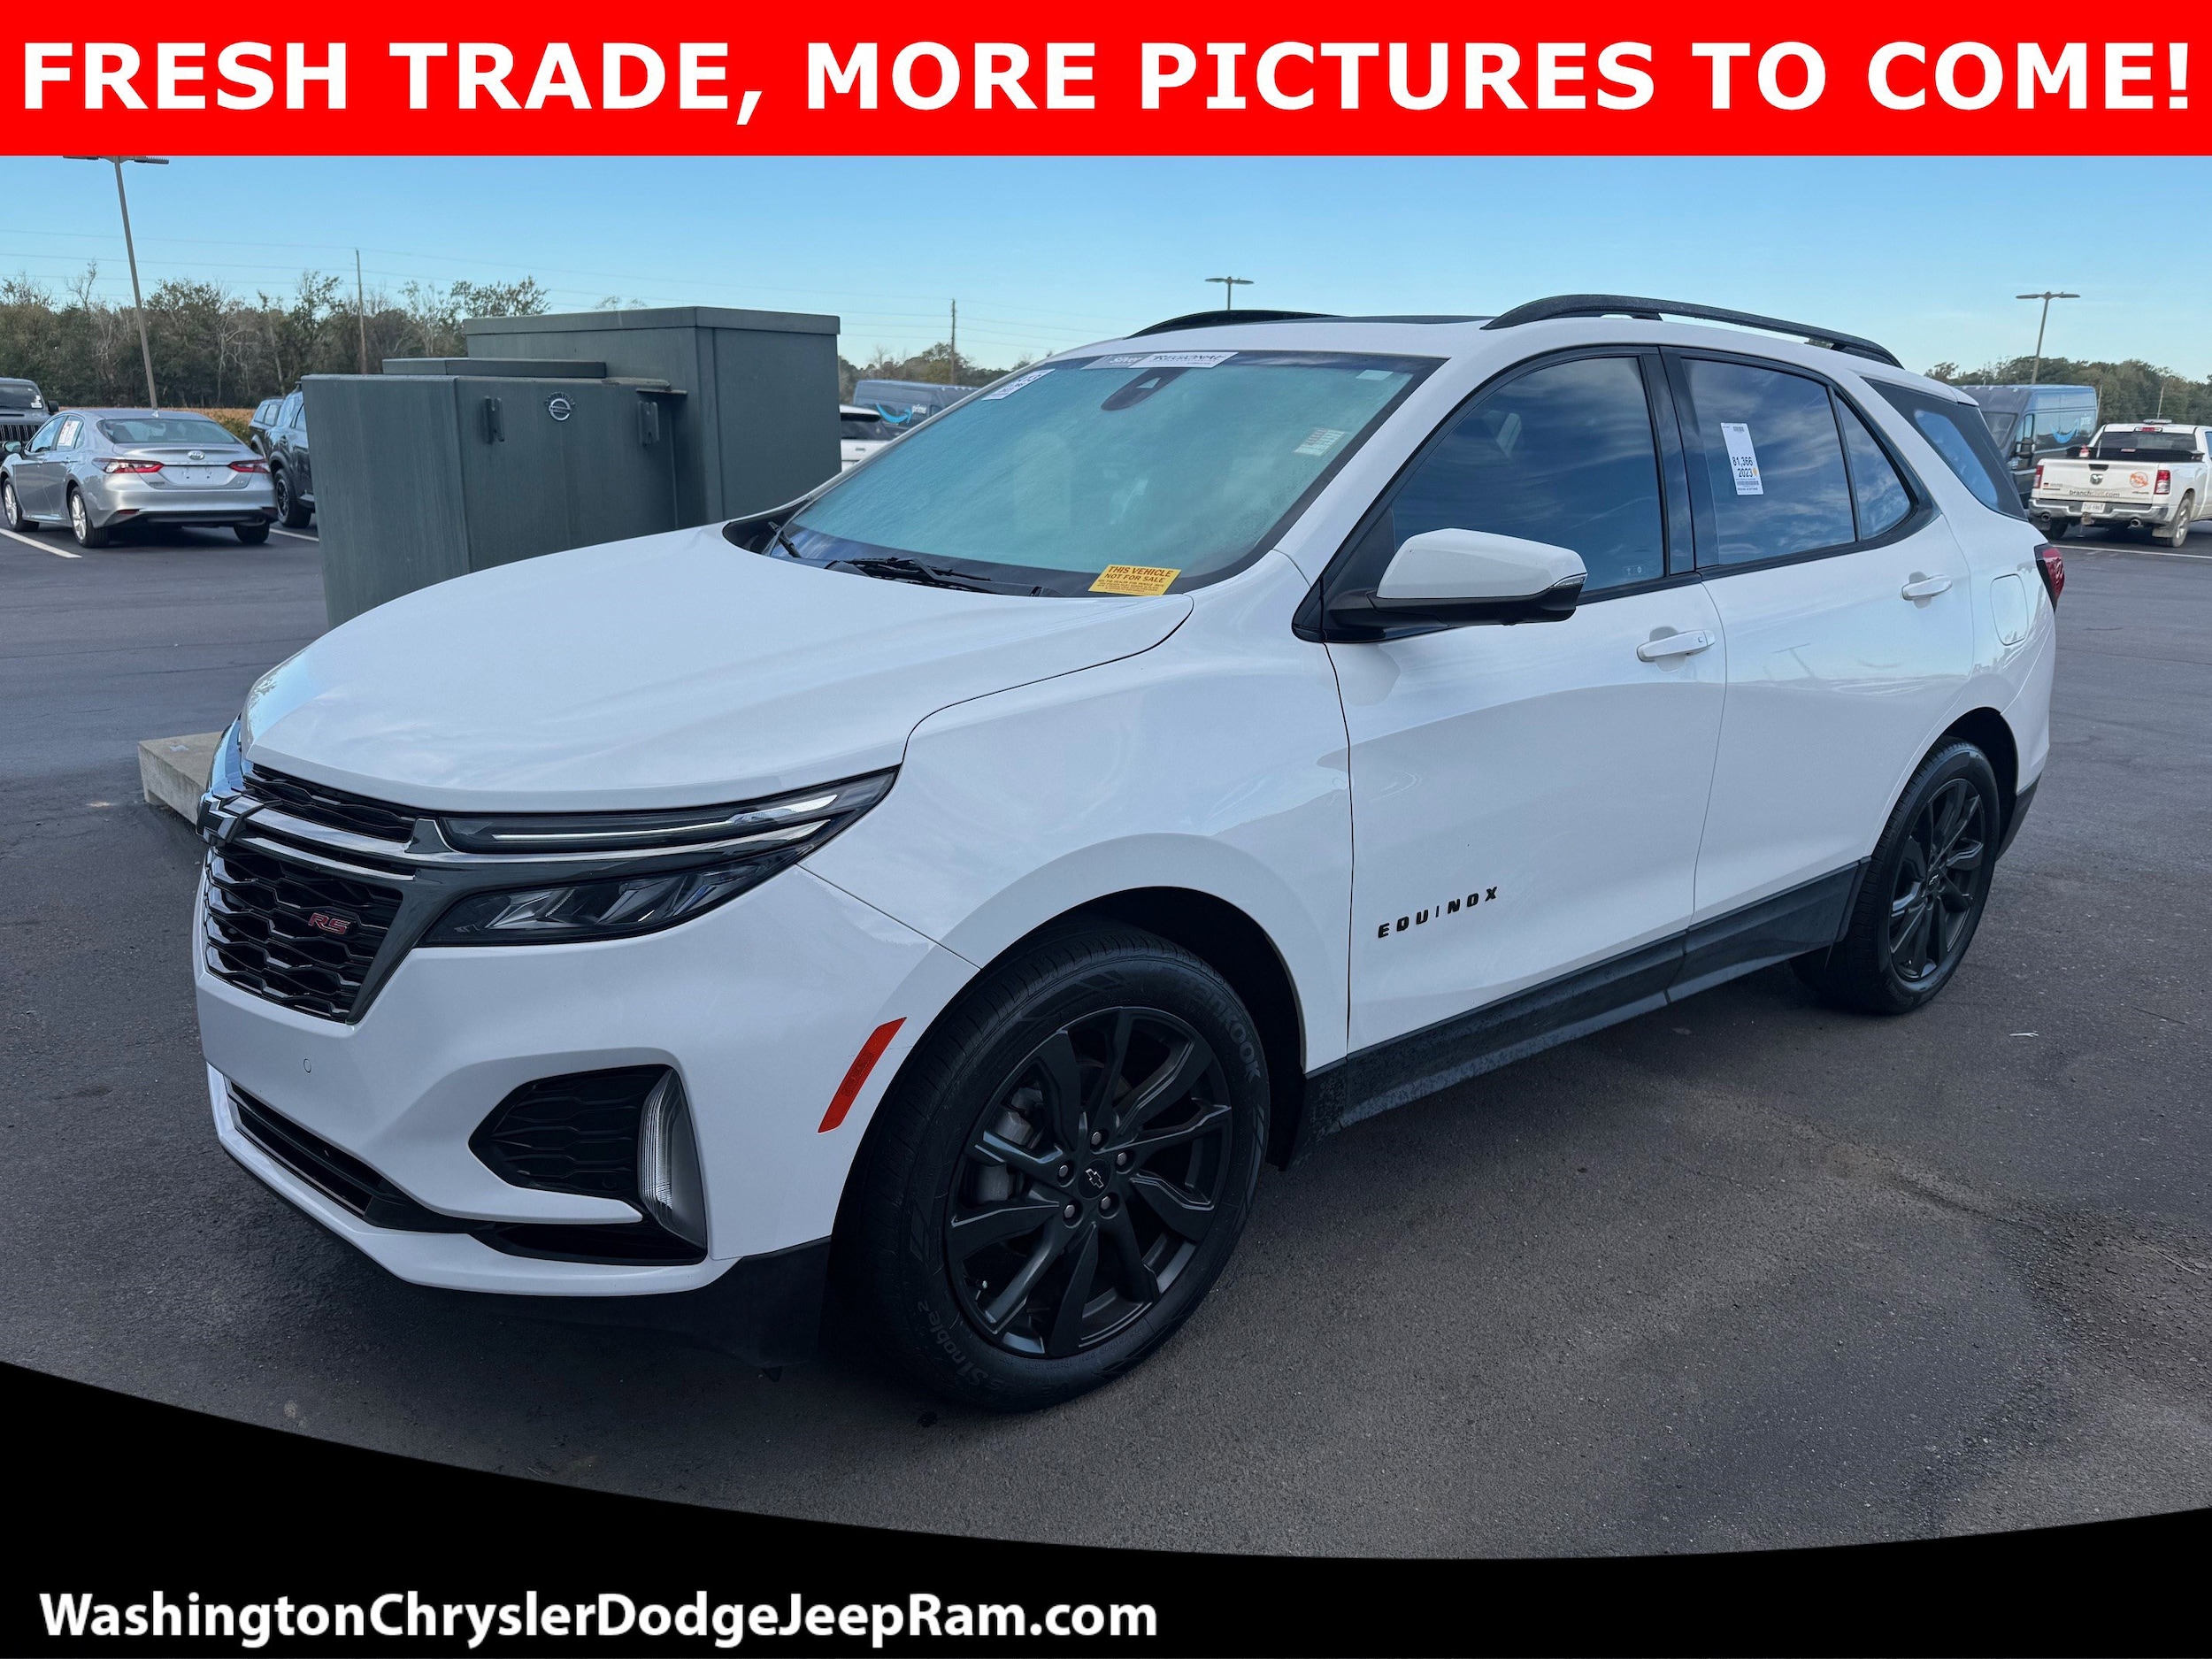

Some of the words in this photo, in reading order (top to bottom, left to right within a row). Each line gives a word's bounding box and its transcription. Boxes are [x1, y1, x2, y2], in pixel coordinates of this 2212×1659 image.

[1732, 457, 1754, 467] 81,366
[1737, 468, 1754, 478] 2023
[1133, 567, 1174, 578] VEHICLE
[1378, 886, 1497, 939] EQUINOX
[308, 912, 350, 934] RS
